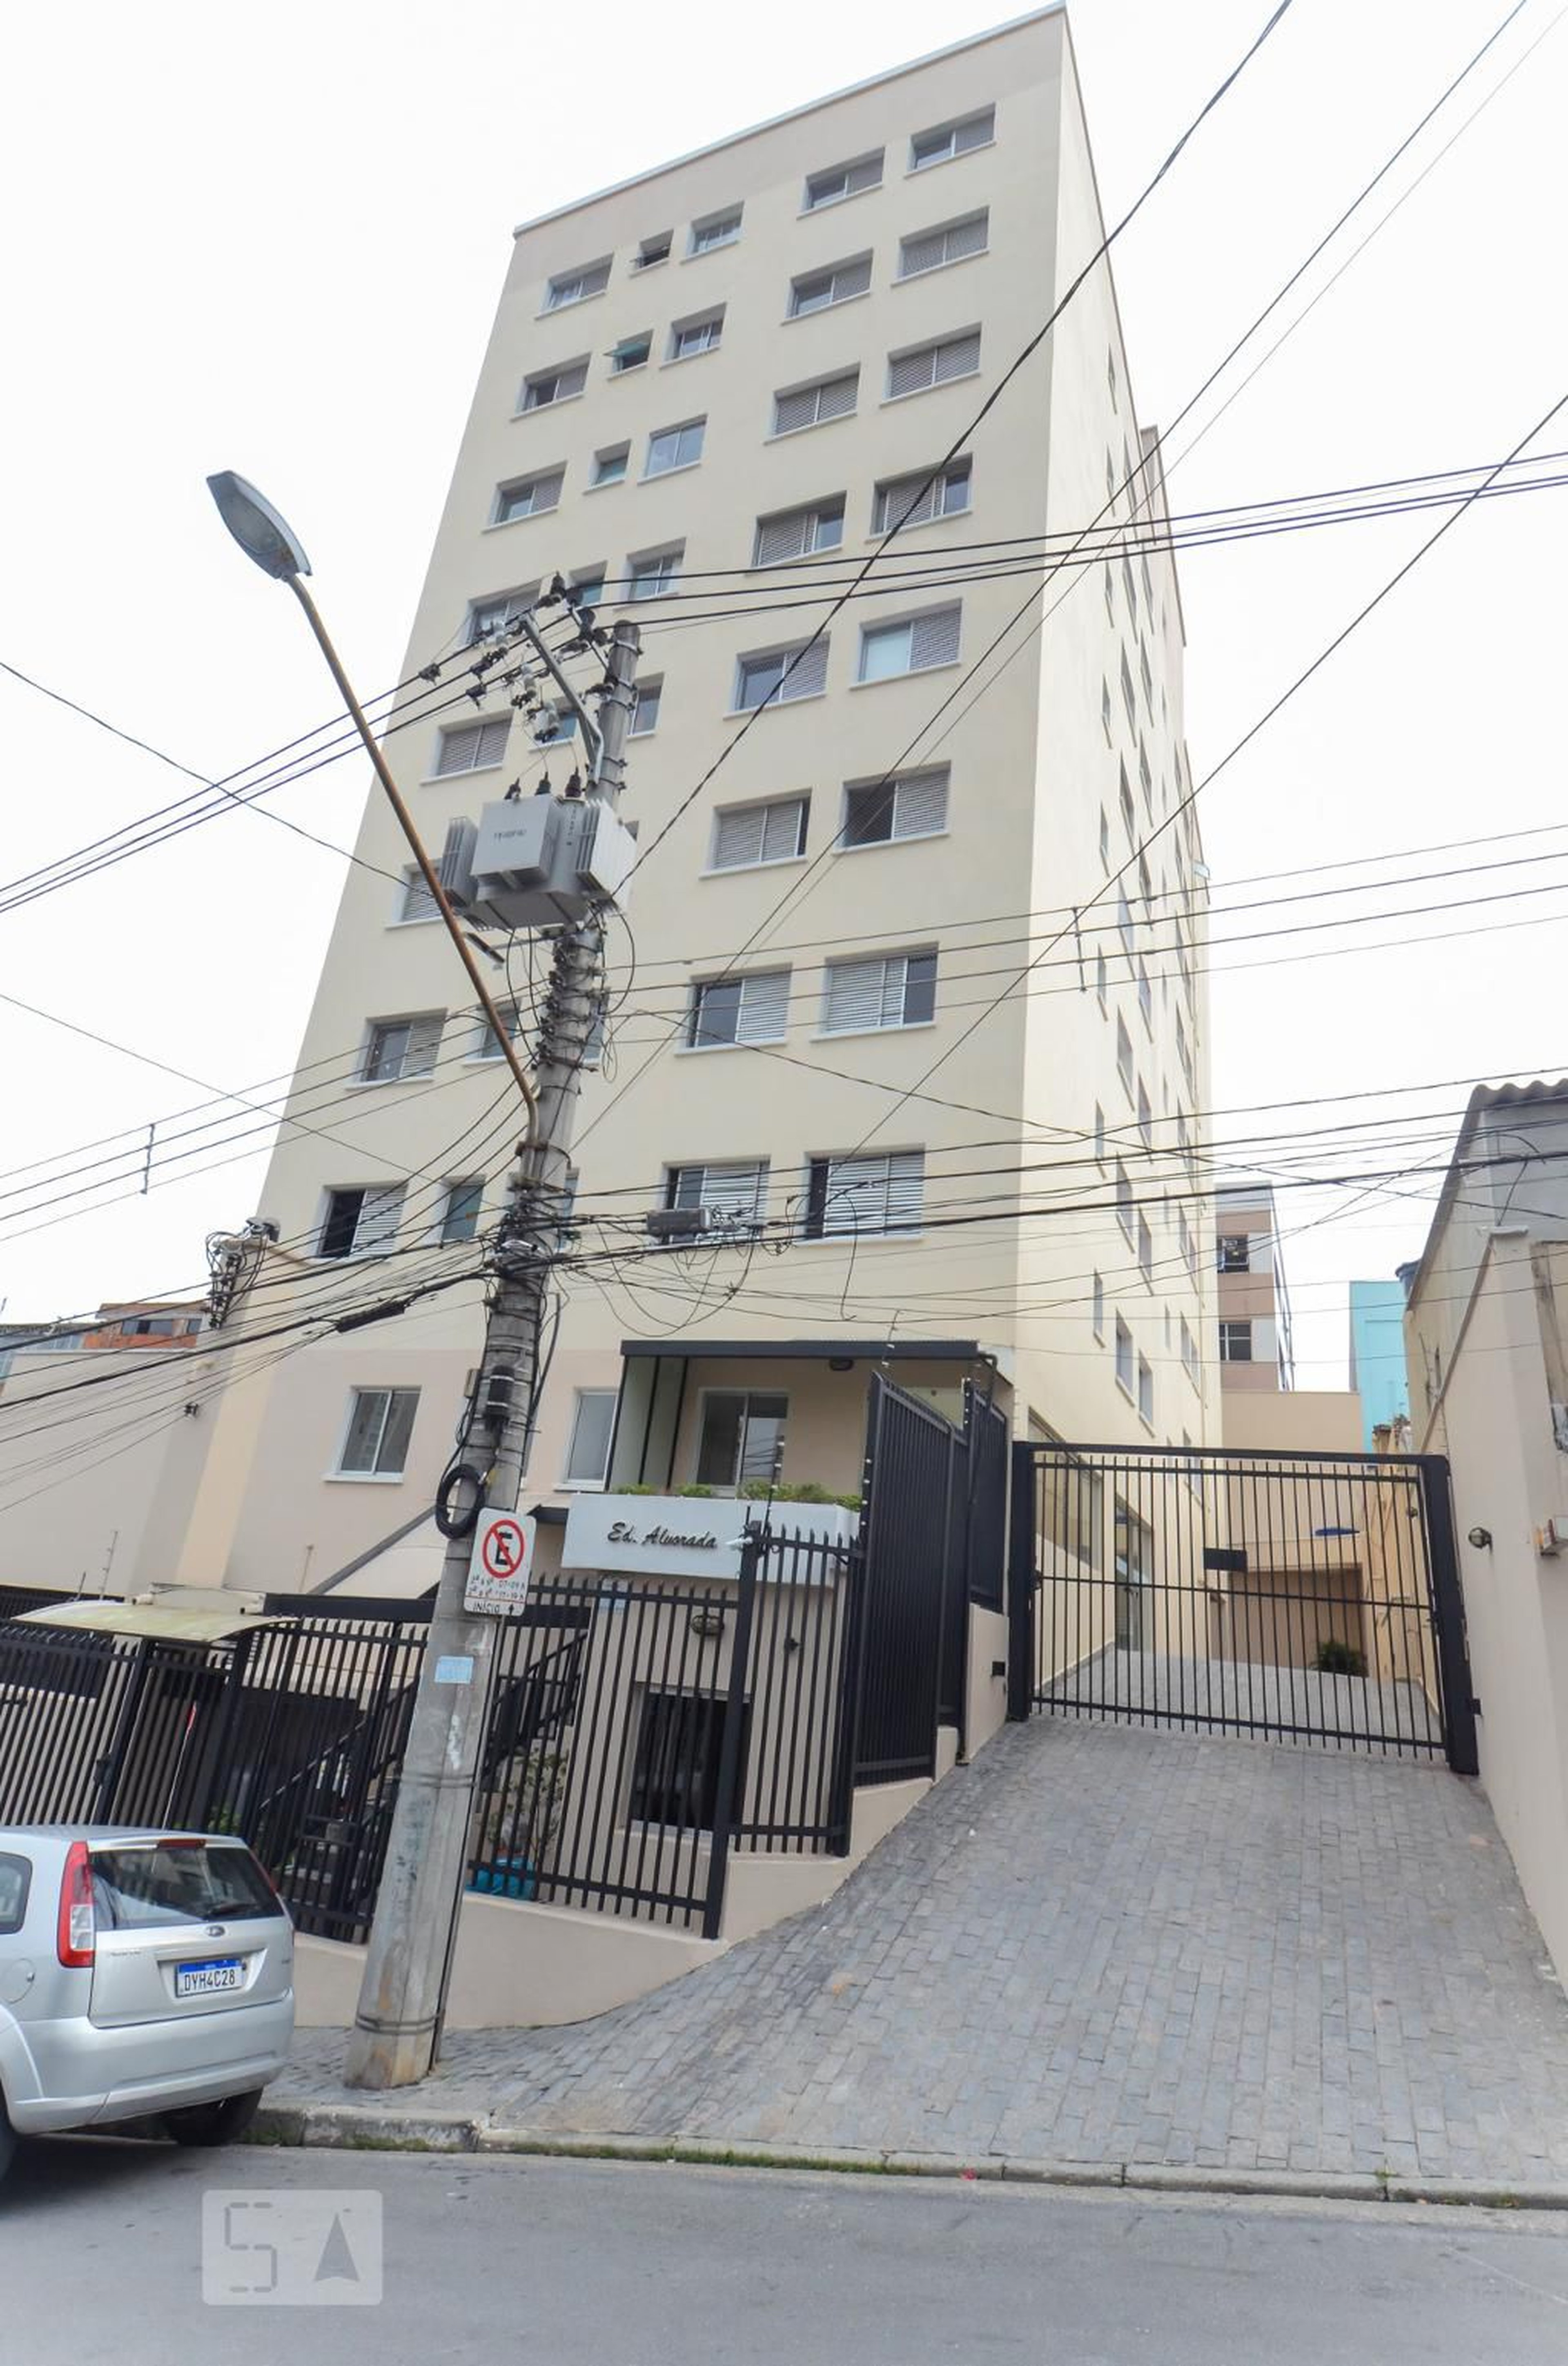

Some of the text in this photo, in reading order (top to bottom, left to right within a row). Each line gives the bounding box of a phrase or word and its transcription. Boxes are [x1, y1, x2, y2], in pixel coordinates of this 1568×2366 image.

[495, 1532, 512, 1566] E
[607, 1522, 717, 1549] Ed. Alvorada
[185, 1969, 235, 1991] DYH4C28
